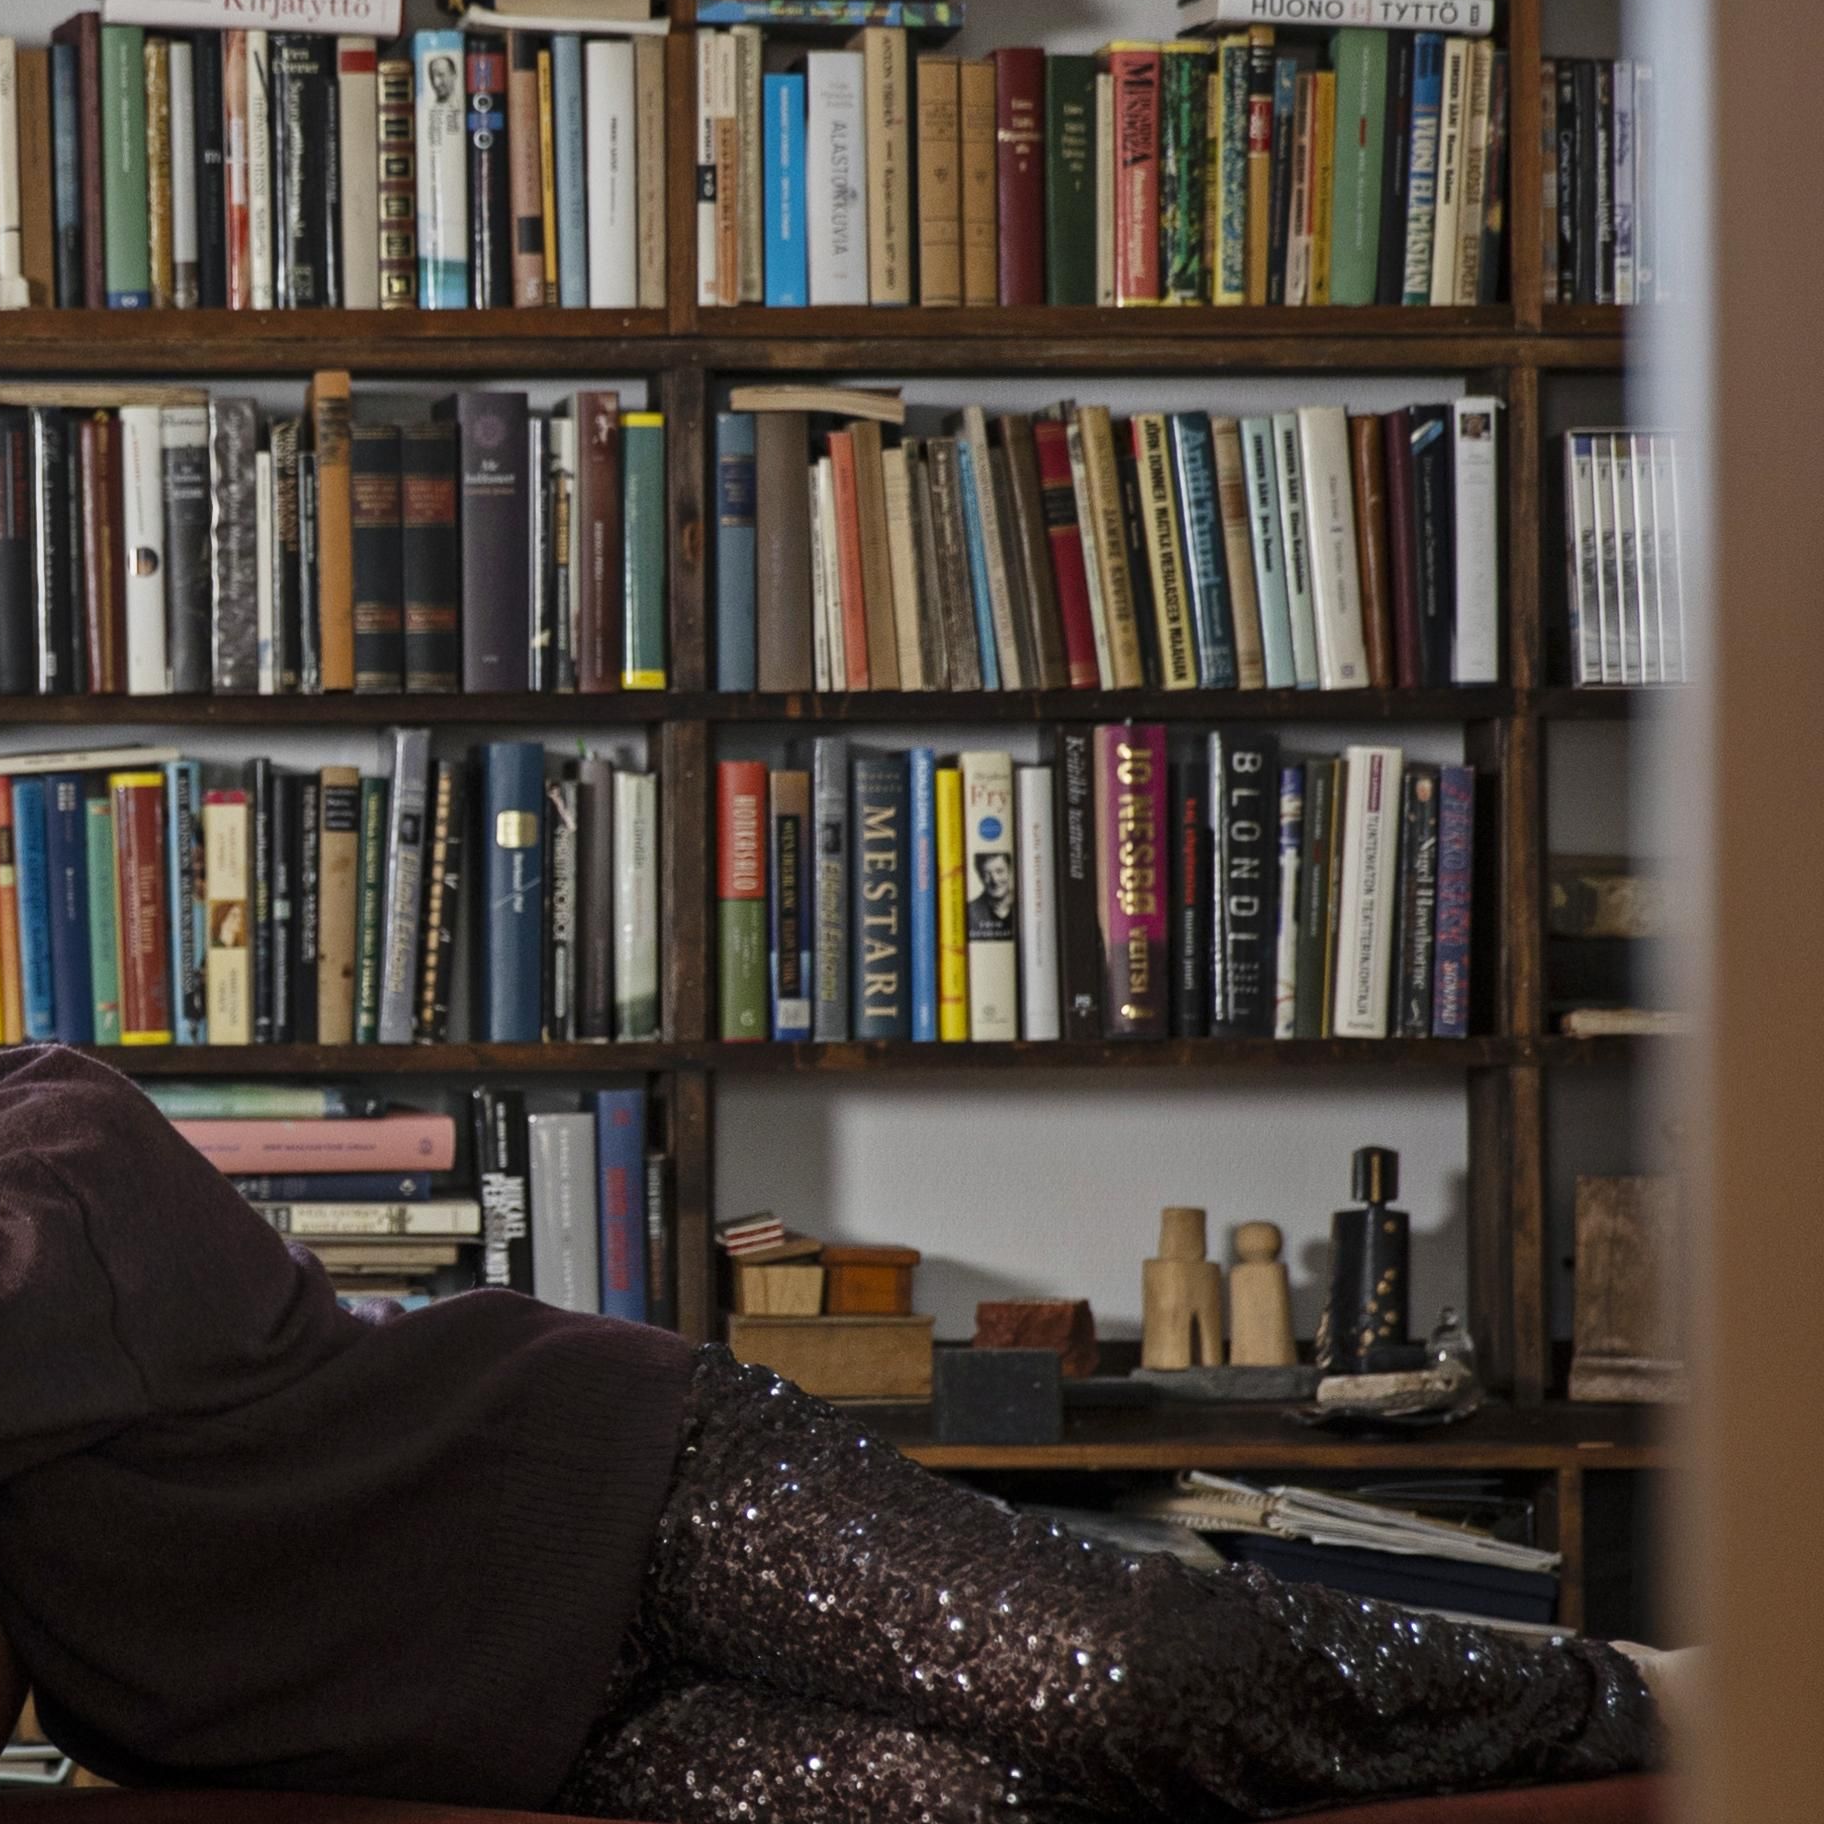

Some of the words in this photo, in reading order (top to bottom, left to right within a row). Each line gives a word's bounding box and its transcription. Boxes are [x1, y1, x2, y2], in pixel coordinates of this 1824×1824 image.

[1379, 1, 1459, 26] TYTTÖ
[1410, 117, 1438, 173] VUOSI
[1144, 420, 1164, 453] JÖRN
[1183, 428, 1213, 500] Antti
[1148, 455, 1169, 504] DONNER
[1155, 508, 1173, 550] MATKA
[1159, 553, 1181, 624] VIERAASEEN
[1169, 628, 1189, 682] MAAHAN
[1115, 743, 1155, 786] JO
[971, 783, 1010, 814] Fry
[1228, 750, 1262, 943] BLONDI
[1363, 815, 1381, 897] TUNTEMATON
[1413, 836, 1435, 884] Nigel
[863, 804, 899, 1019] MESTARI
[1411, 887, 1435, 991] Hawthorne
[1128, 927, 1150, 994] VEITSI
[504, 1176, 527, 1240] MIKAEL
